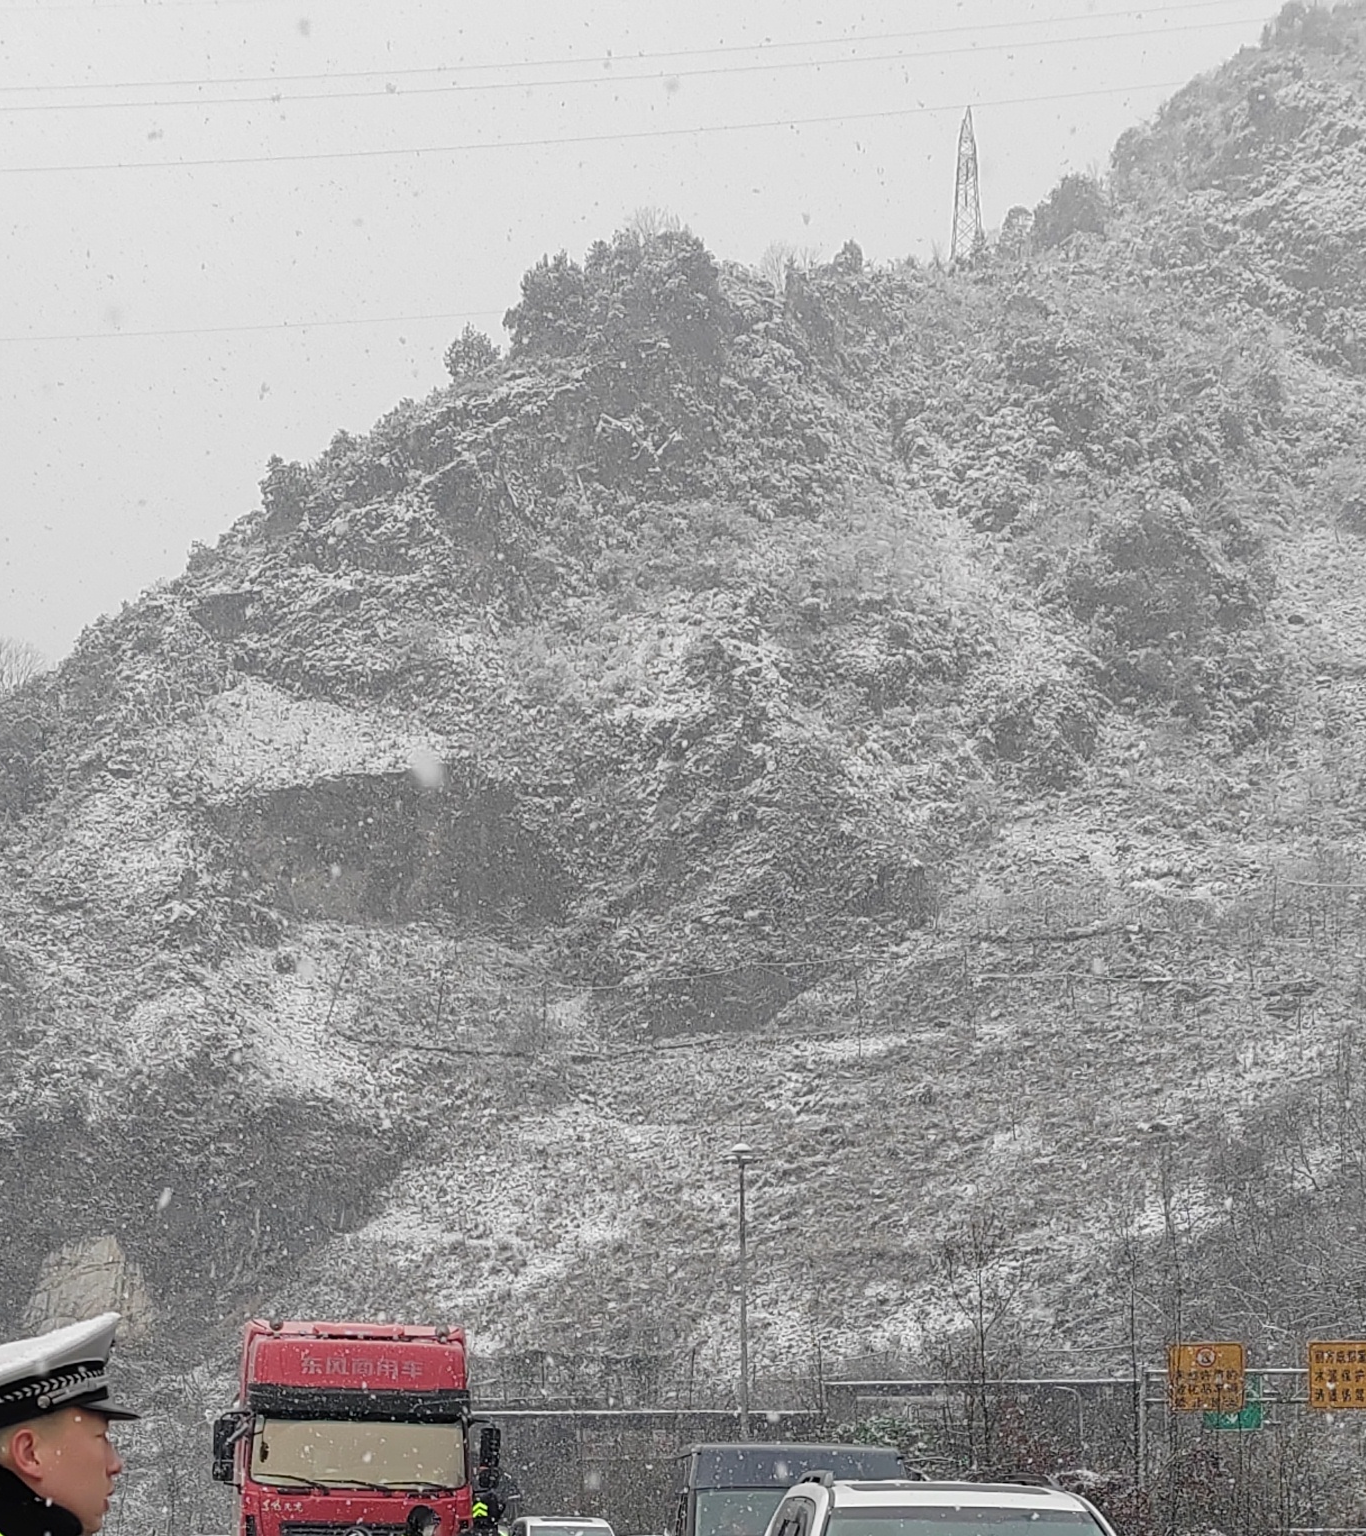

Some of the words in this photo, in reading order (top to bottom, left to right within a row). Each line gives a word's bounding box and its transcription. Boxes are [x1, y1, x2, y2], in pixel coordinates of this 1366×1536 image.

[301, 1356, 423, 1379] 东风商用车
